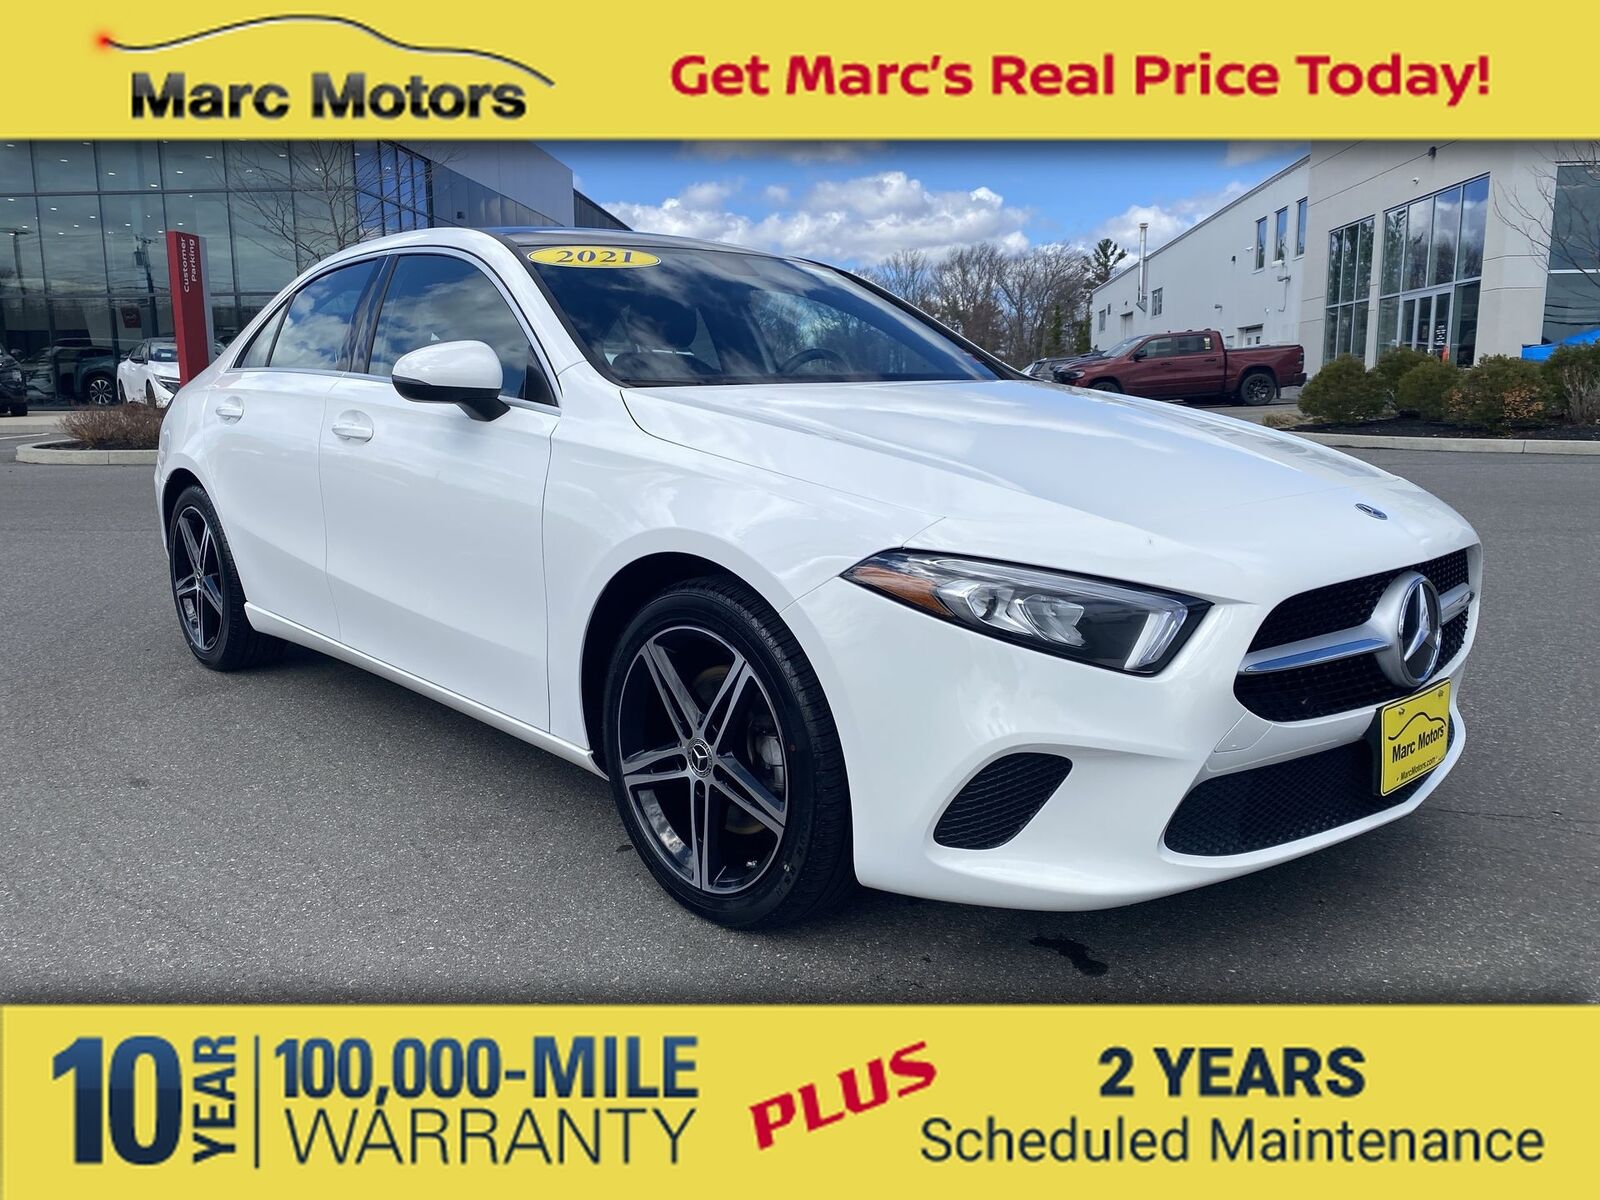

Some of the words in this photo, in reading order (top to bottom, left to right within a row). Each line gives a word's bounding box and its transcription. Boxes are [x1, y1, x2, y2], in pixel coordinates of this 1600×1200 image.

[181, 237, 189, 293] Customer
[189, 239, 197, 282] Parking
[556, 250, 633, 263] 2021
[1392, 741, 1416, 763] Marc
[1418, 727, 1444, 750] Motors
